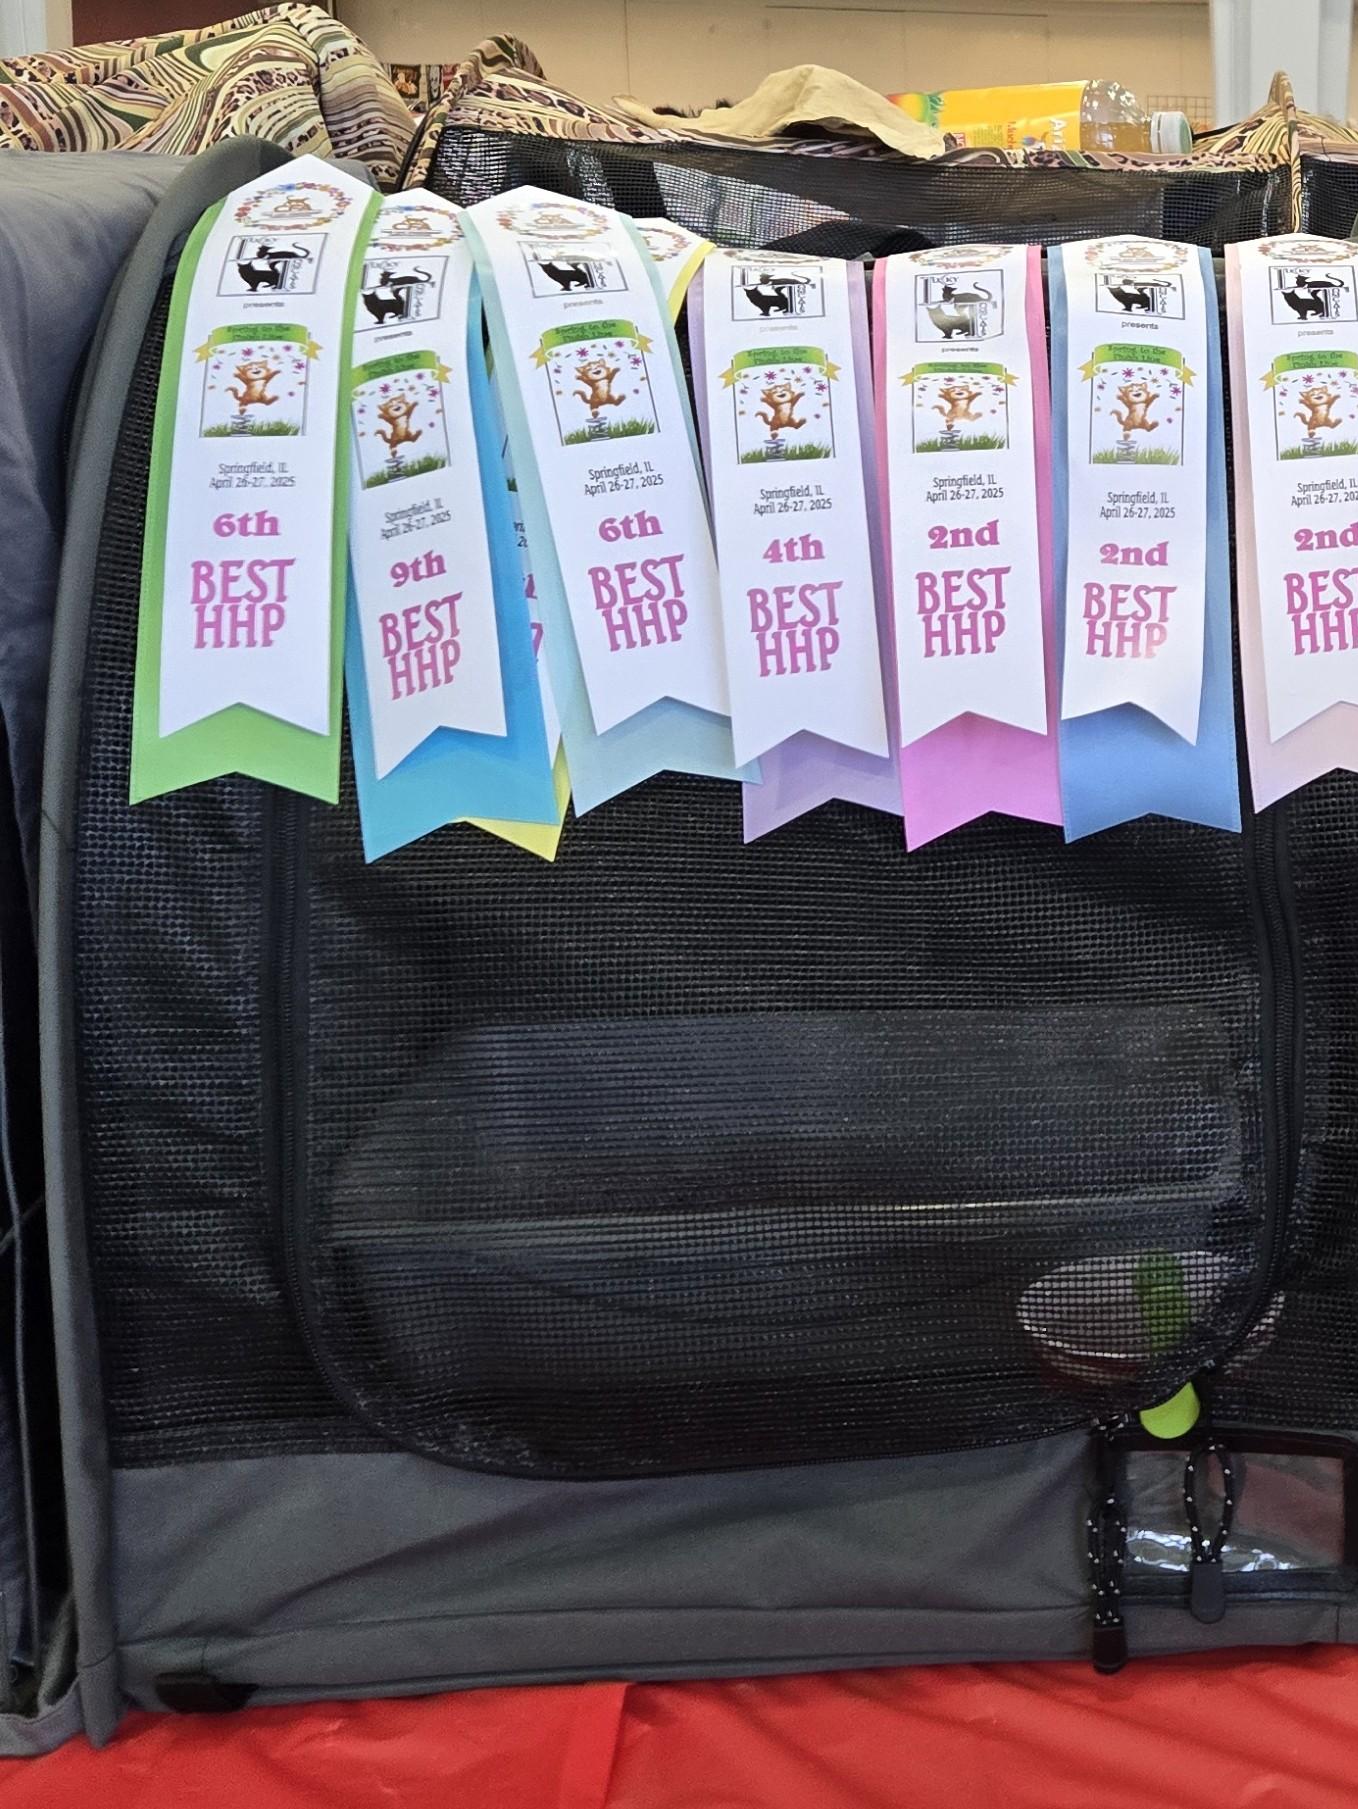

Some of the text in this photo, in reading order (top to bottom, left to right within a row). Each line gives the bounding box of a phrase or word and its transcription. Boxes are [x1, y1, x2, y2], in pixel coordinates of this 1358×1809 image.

[1121, 321, 1159, 330] presents
[209, 477, 232, 490] April
[584, 473, 664, 497] April 26-27, 2025
[588, 461, 654, 482] Springfield, IL
[933, 474, 997, 489] Springfield, IL
[1297, 478, 1358, 494] Springfield, IL
[753, 498, 832, 516] April 26-27, 2025
[760, 485, 824, 502] Springfield, IL
[926, 488, 1004, 504] April 26-27, 2025
[1107, 491, 1169, 506] Springfield, IL
[1291, 495, 1312, 508] April
[1314, 493, 1342, 505] 26-27,
[213, 509, 281, 537] 6th
[598, 509, 664, 542] 6th
[1100, 506, 1175, 520] April 26-27, 2025
[762, 533, 825, 563] 4th
[928, 519, 999, 549] 2nd
[390, 550, 447, 587] 9th
[1099, 541, 1169, 566] 2nd
[190, 558, 297, 604] BEST
[587, 554, 684, 610] BEST
[915, 566, 1011, 615] BEST
[746, 581, 843, 633] BEST
[1083, 582, 1177, 623] BEST
[194, 602, 286, 649] HHP
[379, 591, 463, 657] BEST
[601, 599, 688, 652] HHP
[922, 610, 1006, 658] HHP
[756, 626, 840, 677] HHP
[1085, 620, 1168, 659] HHP
[387, 639, 461, 700] HHP
